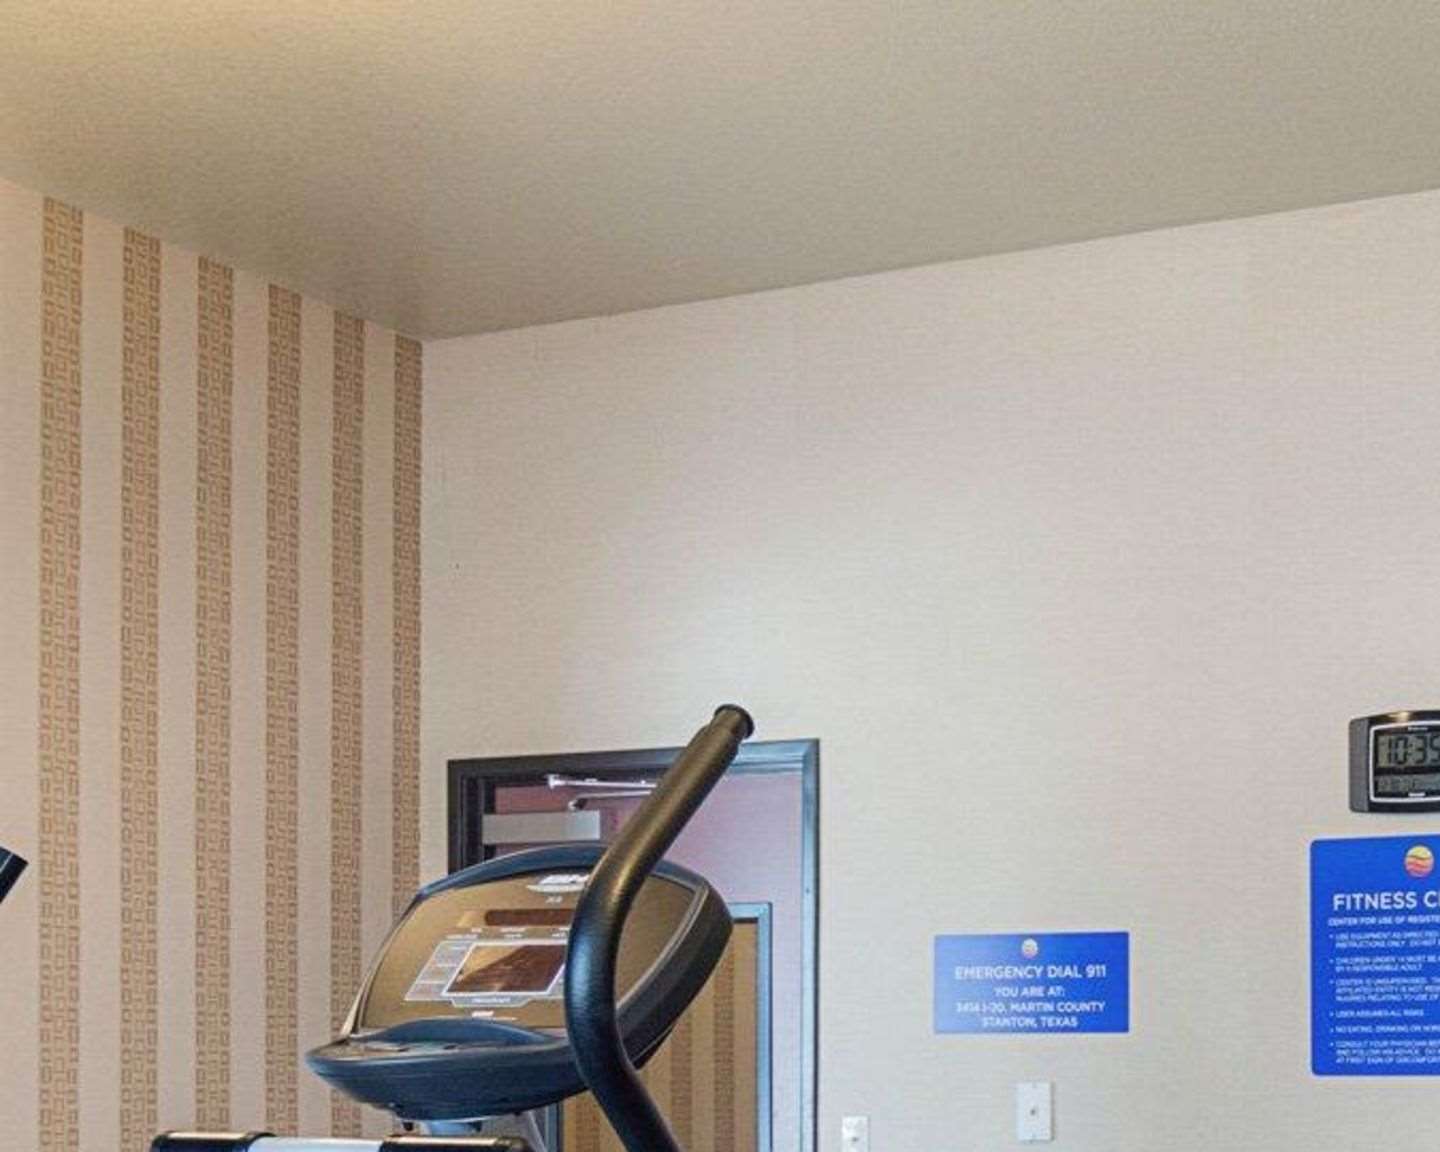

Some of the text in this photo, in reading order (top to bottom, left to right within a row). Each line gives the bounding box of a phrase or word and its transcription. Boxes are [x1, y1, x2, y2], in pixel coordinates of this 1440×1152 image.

[1333, 891, 1417, 911] FITNESS
[1360, 916, 1376, 924] FOR
[955, 965, 1107, 980] EMERGENCY DIAL 911
[994, 986, 1018, 997] YOU
[1020, 986, 1044, 997] ARE
[1010, 1002, 1055, 1012] MARTIN
[1056, 1001, 1105, 1012] COUNTY
[1041, 1016, 1078, 1027] TEXAS
